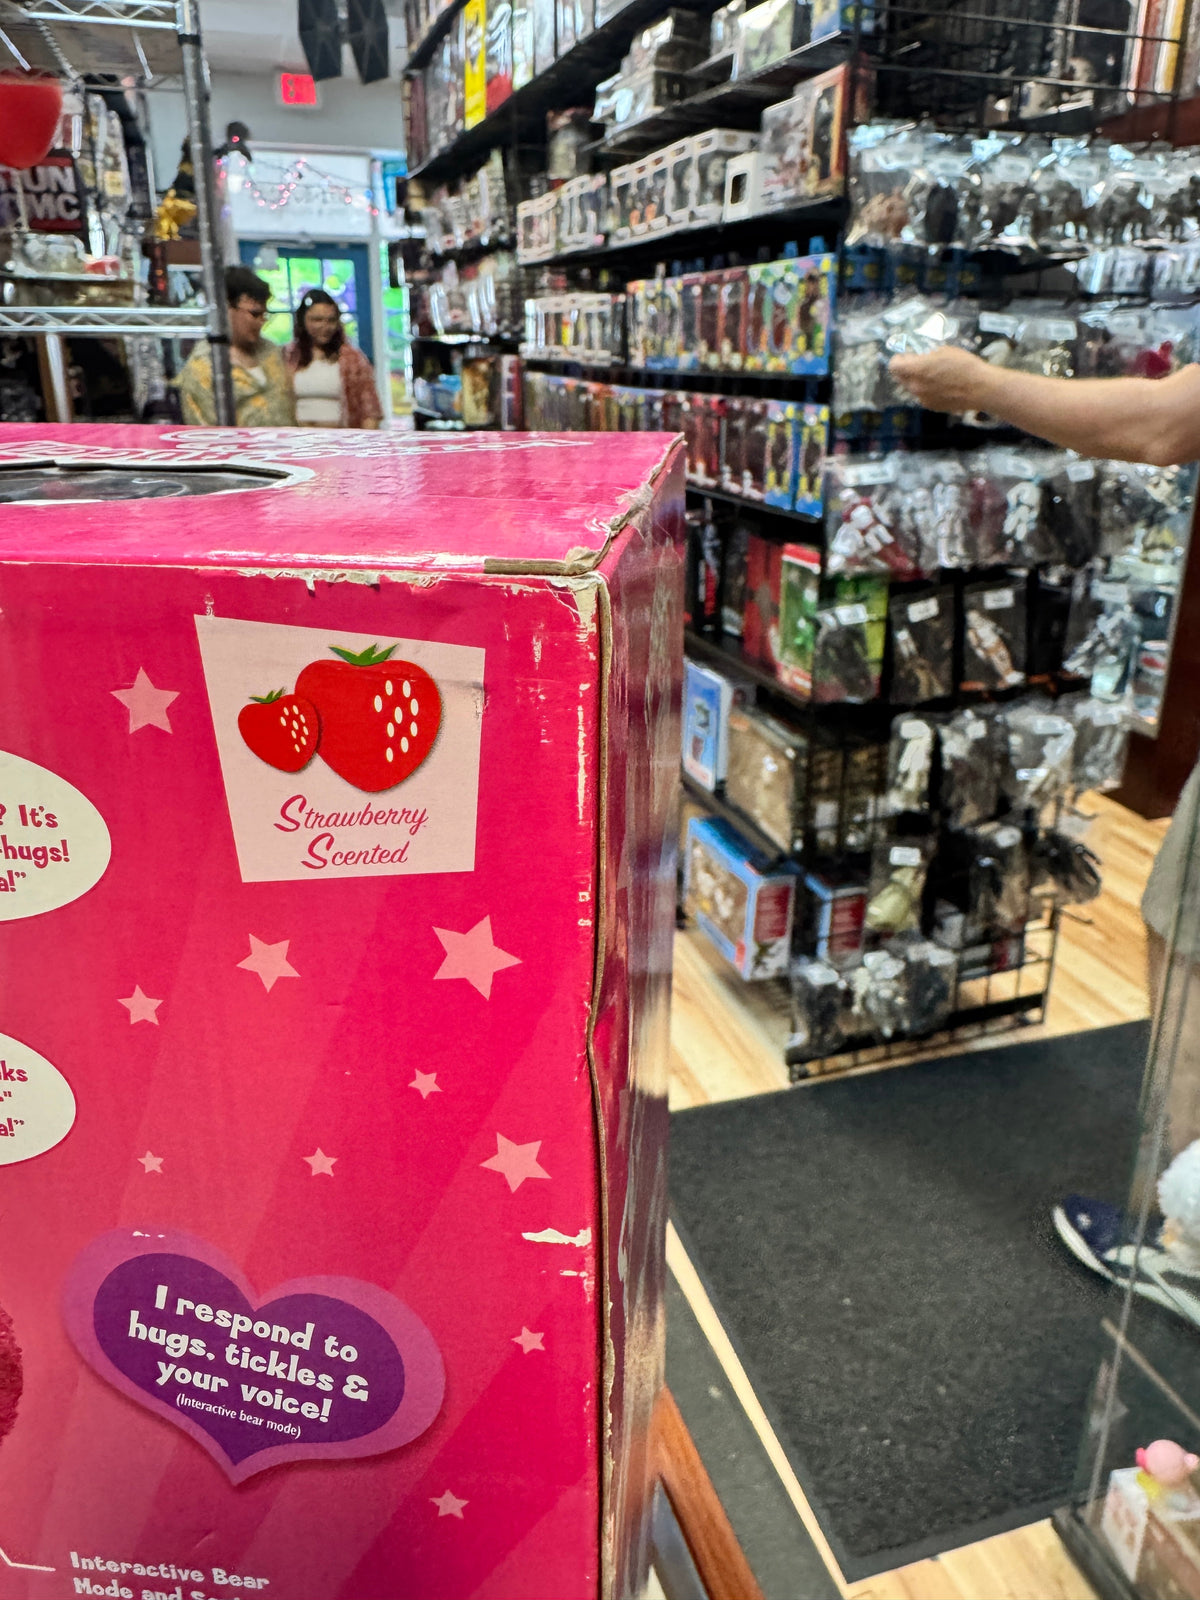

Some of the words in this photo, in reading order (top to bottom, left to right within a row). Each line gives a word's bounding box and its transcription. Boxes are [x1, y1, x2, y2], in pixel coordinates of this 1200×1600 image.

[273, 794, 429, 836] Strawberry
[301, 832, 410, 870] Scented
[0, 1060, 28, 1082] ks
[154, 1284, 169, 1310] I
[176, 1298, 315, 1351] respond
[324, 1335, 358, 1363] to
[155, 1361, 229, 1393] your
[241, 1384, 332, 1423] voice!
[225, 1343, 335, 1392] tickles
[342, 1374, 369, 1402] &
[176, 1393, 237, 1420] (Interactive
[239, 1410, 265, 1427] bear
[266, 1420, 302, 1440] mode)
[70, 1551, 205, 1583] Interactive
[211, 1567, 270, 1590] Bear
[73, 1577, 133, 1599] Mode
[142, 1586, 183, 1600] and
